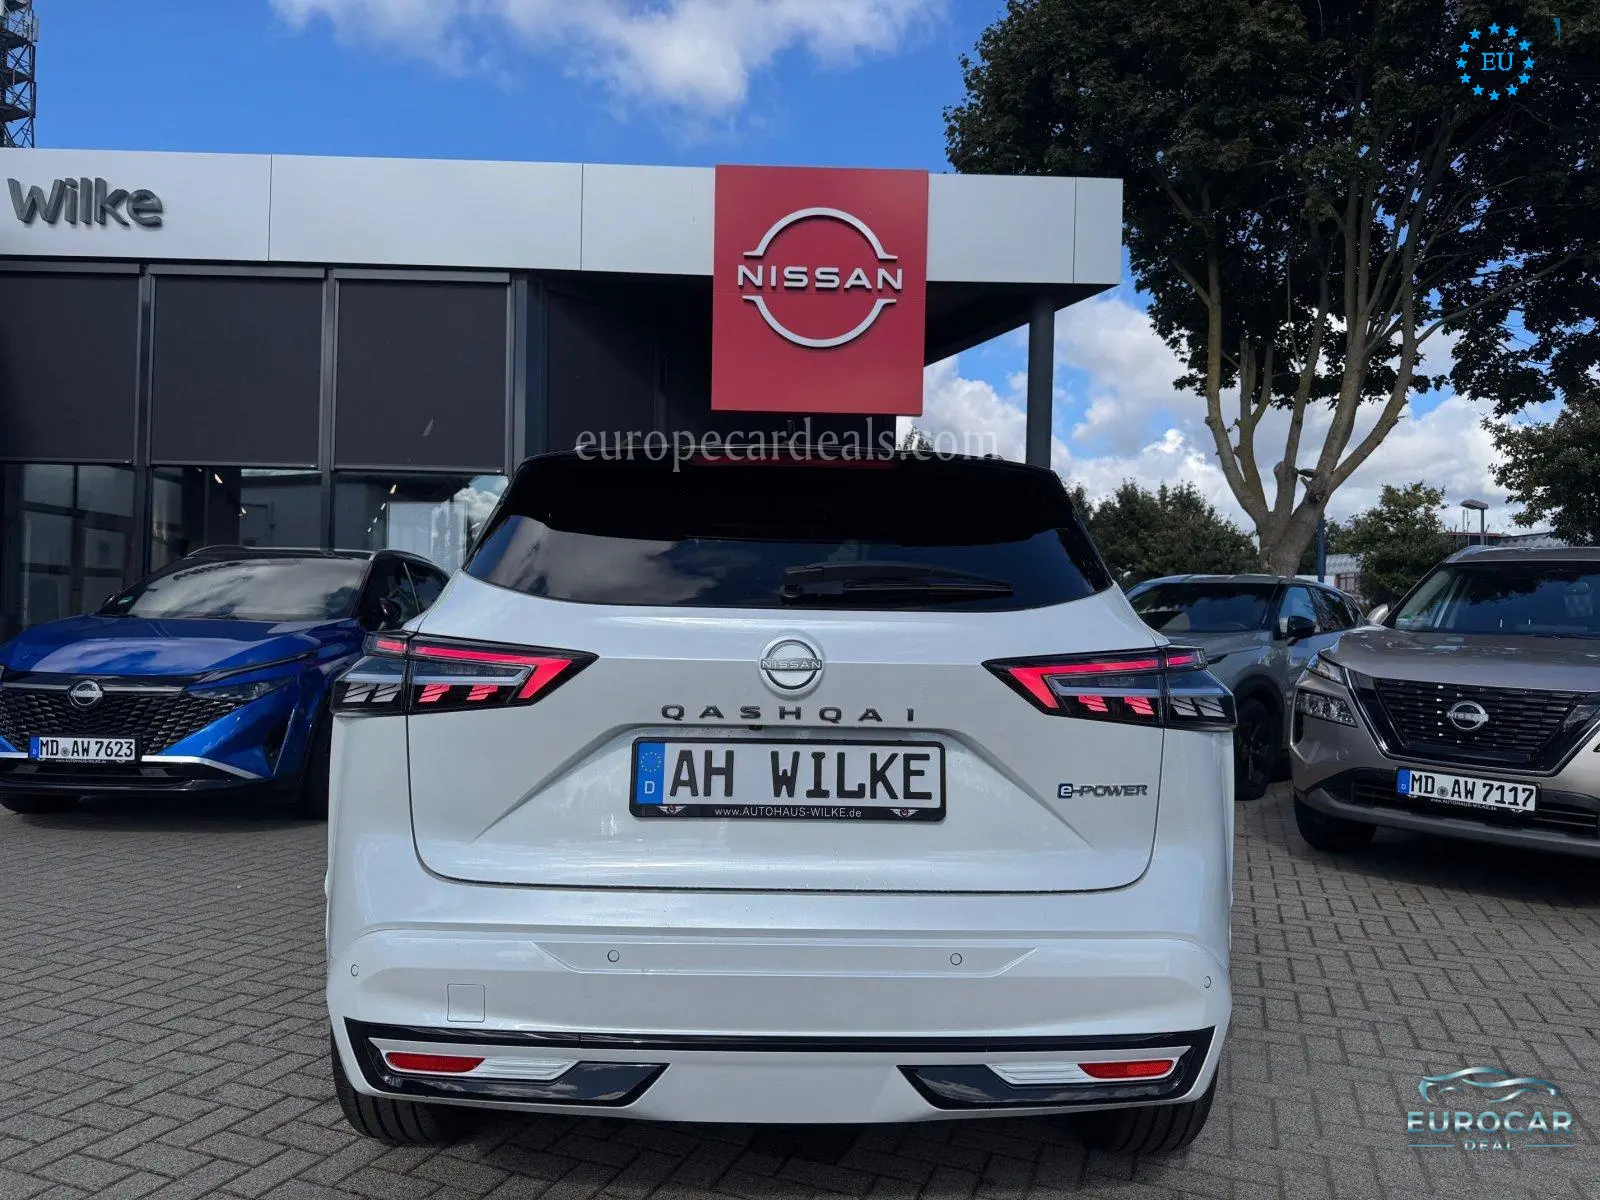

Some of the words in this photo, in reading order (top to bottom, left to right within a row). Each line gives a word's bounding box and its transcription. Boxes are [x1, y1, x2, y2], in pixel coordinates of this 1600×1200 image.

[7, 177, 163, 229] Wilke
[737, 264, 903, 292] NISSAN
[762, 660, 821, 669] NISSAN
[661, 704, 915, 723] QASHQAI
[40, 739, 59, 756] MD
[71, 740, 91, 757] AW
[95, 741, 134, 758] 7623
[669, 750, 735, 797] AH
[770, 751, 933, 800] WILKE
[644, 780, 656, 795] D
[1411, 773, 1435, 794] MD
[1450, 779, 1476, 800] AW
[1482, 783, 1534, 807] 7117
[715, 806, 862, 818] www.AUTOHAUS-WILKE.de
